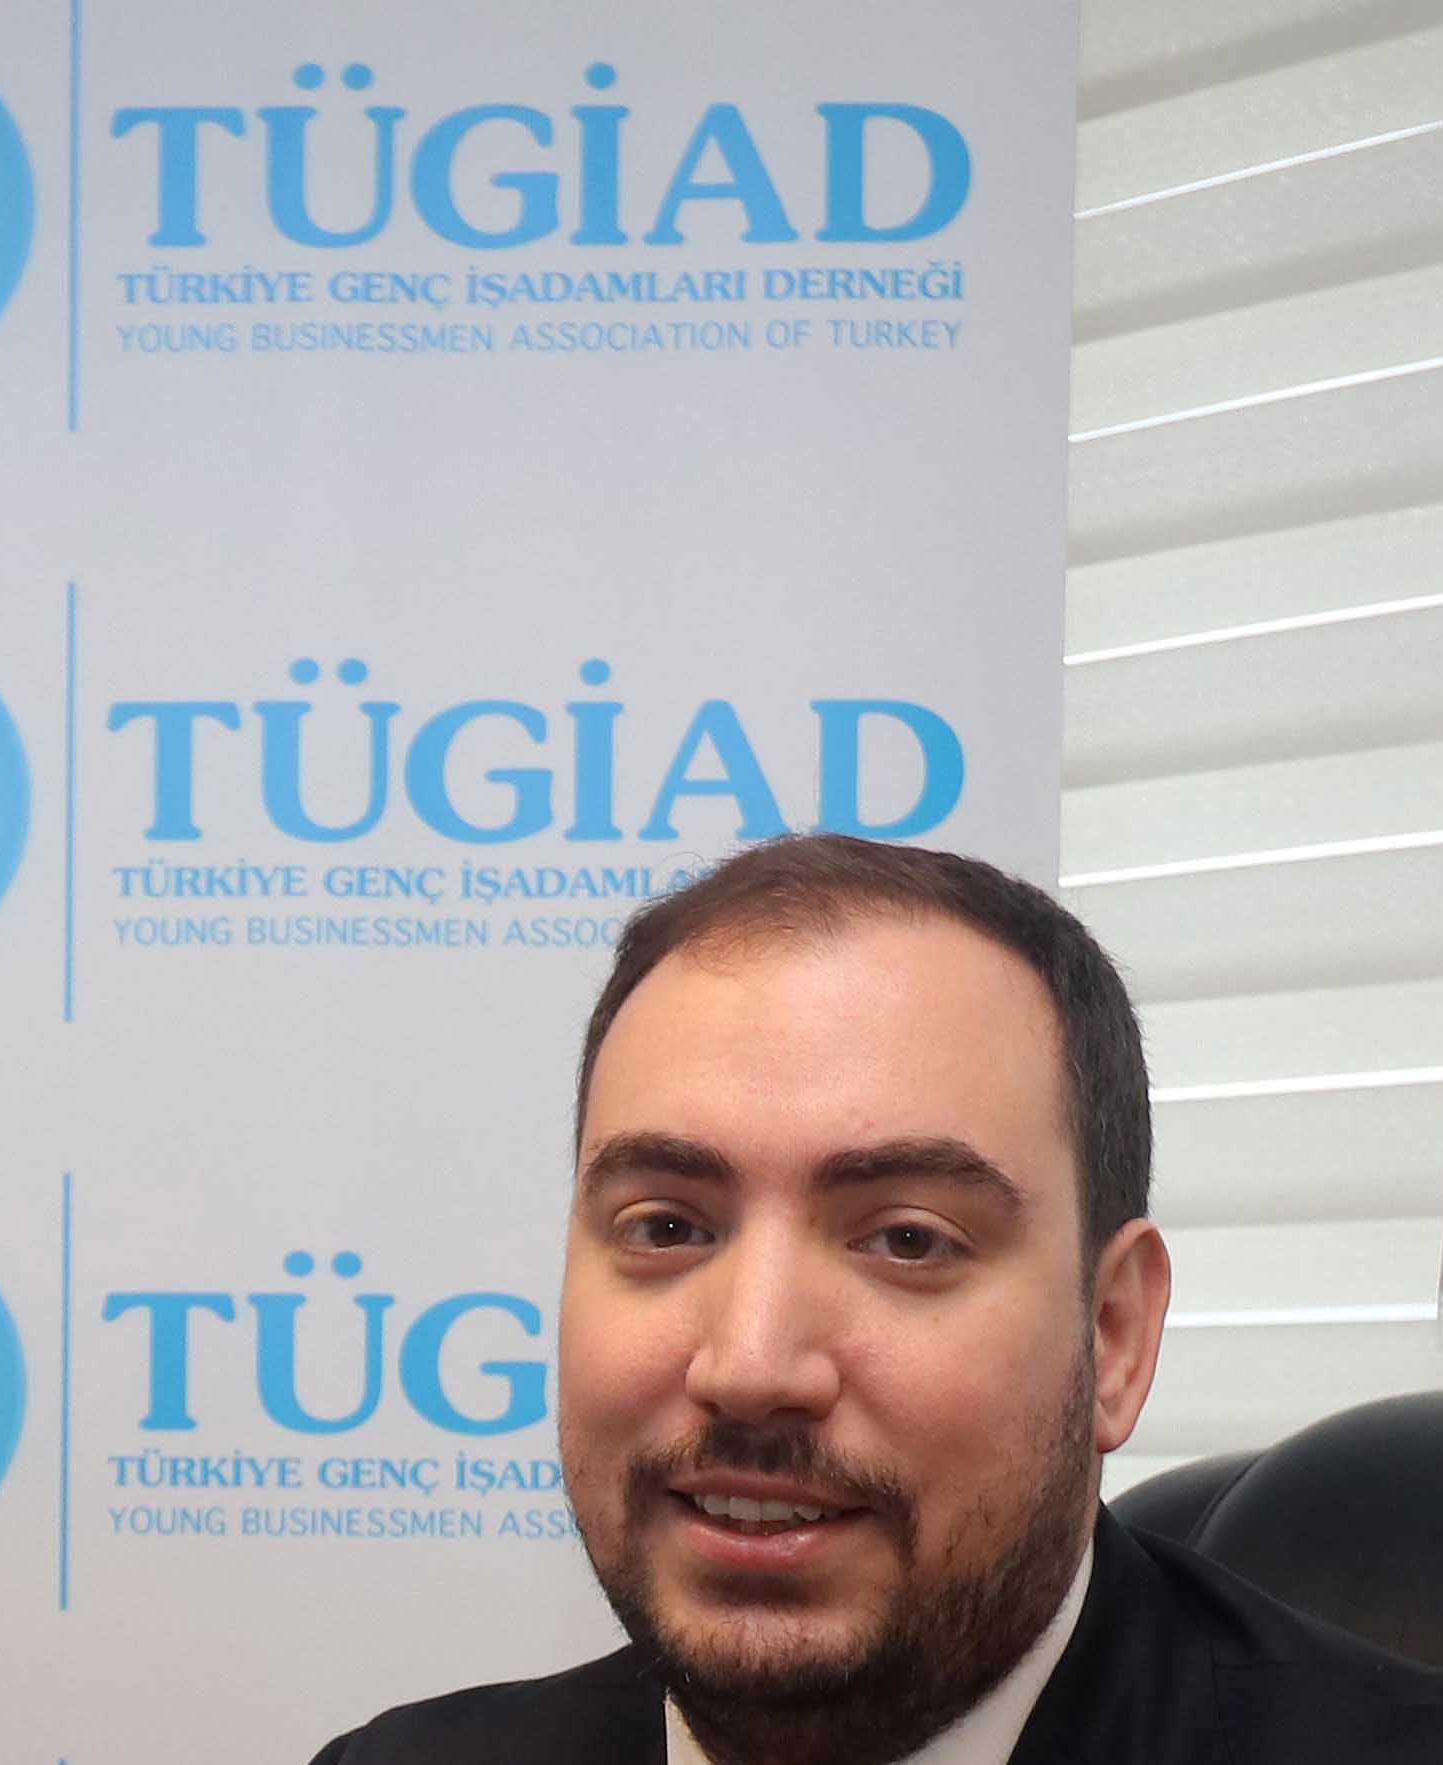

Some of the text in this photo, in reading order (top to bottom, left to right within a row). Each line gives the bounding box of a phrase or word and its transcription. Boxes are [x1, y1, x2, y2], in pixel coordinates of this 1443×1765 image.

[111, 62, 974, 252] TÜGİAD
[115, 261, 966, 312] TÜRKİYE GENÇ İŞADAMLARI DERNEĞİ
[117, 319, 964, 355] YOUNG BUSINESSMEN ASSOCIATION OF TURKEY
[108, 658, 967, 848] TÜGİAD
[114, 861, 708, 906] TÜRKİYE GENÇ İŞADAMLA
[115, 916, 234, 948] YOUNG
[247, 916, 493, 948] BUSINESSMEN
[102, 1251, 551, 1439] TÜG
[109, 1453, 302, 1490] TÜRKİYE
[318, 1457, 440, 1497] GENÇ
[109, 1508, 227, 1538] YOUNG
[241, 1508, 484, 1539] BUSINESSMEN
